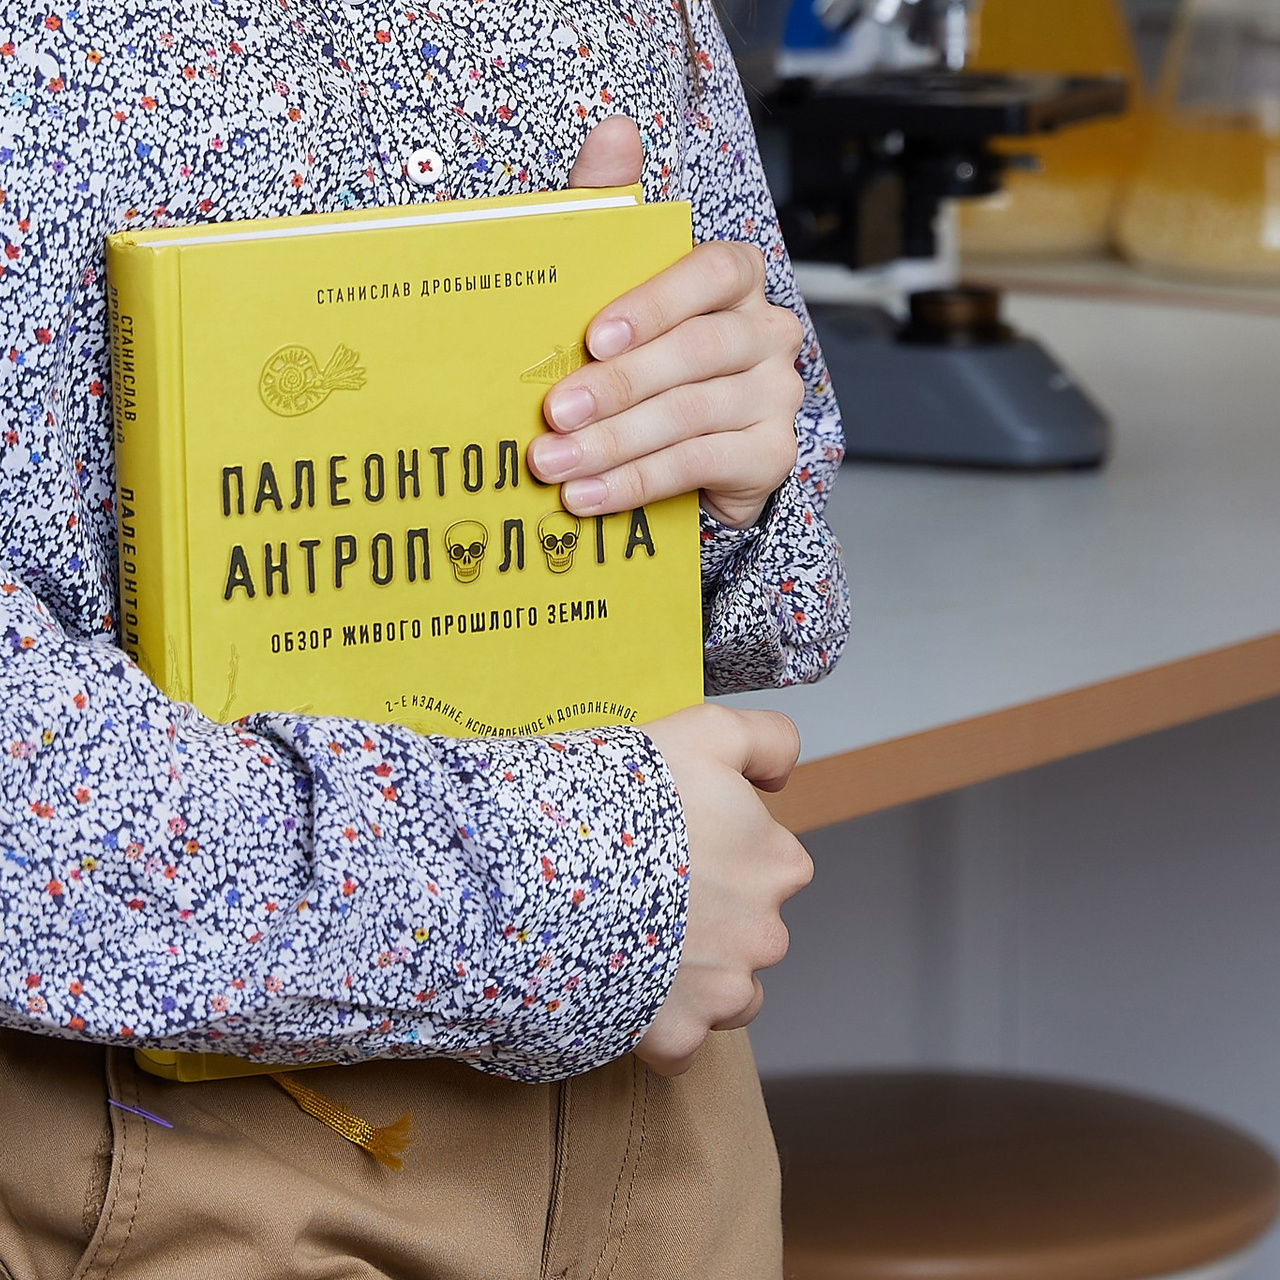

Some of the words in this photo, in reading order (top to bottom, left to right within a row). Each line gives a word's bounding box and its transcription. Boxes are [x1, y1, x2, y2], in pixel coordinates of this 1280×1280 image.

[316, 281, 412, 305] СТАНИСЛАВ
[420, 265, 558, 297] ДРОБЫШЕВСКИЙ
[109, 285, 125, 443] ДРОБЫШЕВСКИЙ
[121, 315, 137, 422] СТАНИСЛАВ
[222, 440, 546, 517] ПАЛЕОНТОЛ
[121, 487, 139, 663] ПАЛЕОНТОЛО
[271, 628, 333, 654] ОБЗОР
[343, 619, 421, 647] ЖИВОГО
[431, 607, 537, 637] ПРОШЛОГО
[547, 599, 609, 625] ЗЕМЛИ
[412, 694, 464, 726] ИЗДАНИЕ,
[546, 714, 555, 726] И
[557, 701, 639, 723] ДОПОЛНЕННОЕ
